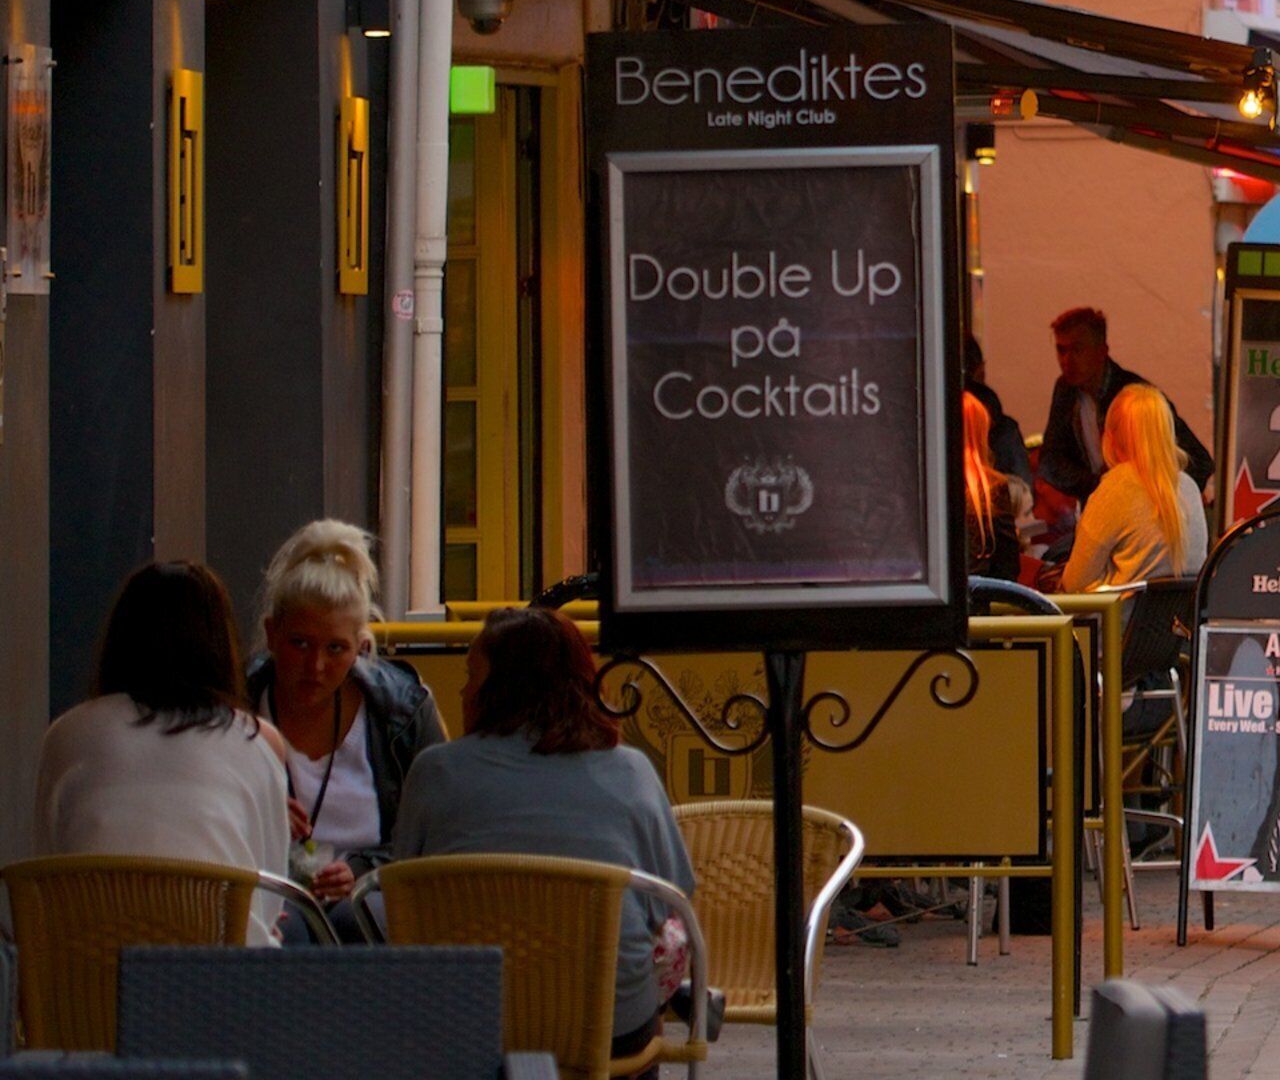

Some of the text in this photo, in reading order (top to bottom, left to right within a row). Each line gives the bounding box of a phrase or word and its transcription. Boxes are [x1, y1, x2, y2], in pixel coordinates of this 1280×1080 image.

[615, 50, 926, 106] Benediktes
[708, 108, 836, 128] Late Night Club
[630, 249, 900, 305] Double Up
[732, 318, 800, 367] på
[653, 369, 881, 420] Cocktails
[1208, 683, 1273, 719] Live
[1208, 719, 1238, 735] Every
[1240, 720, 1267, 735] Wed.
